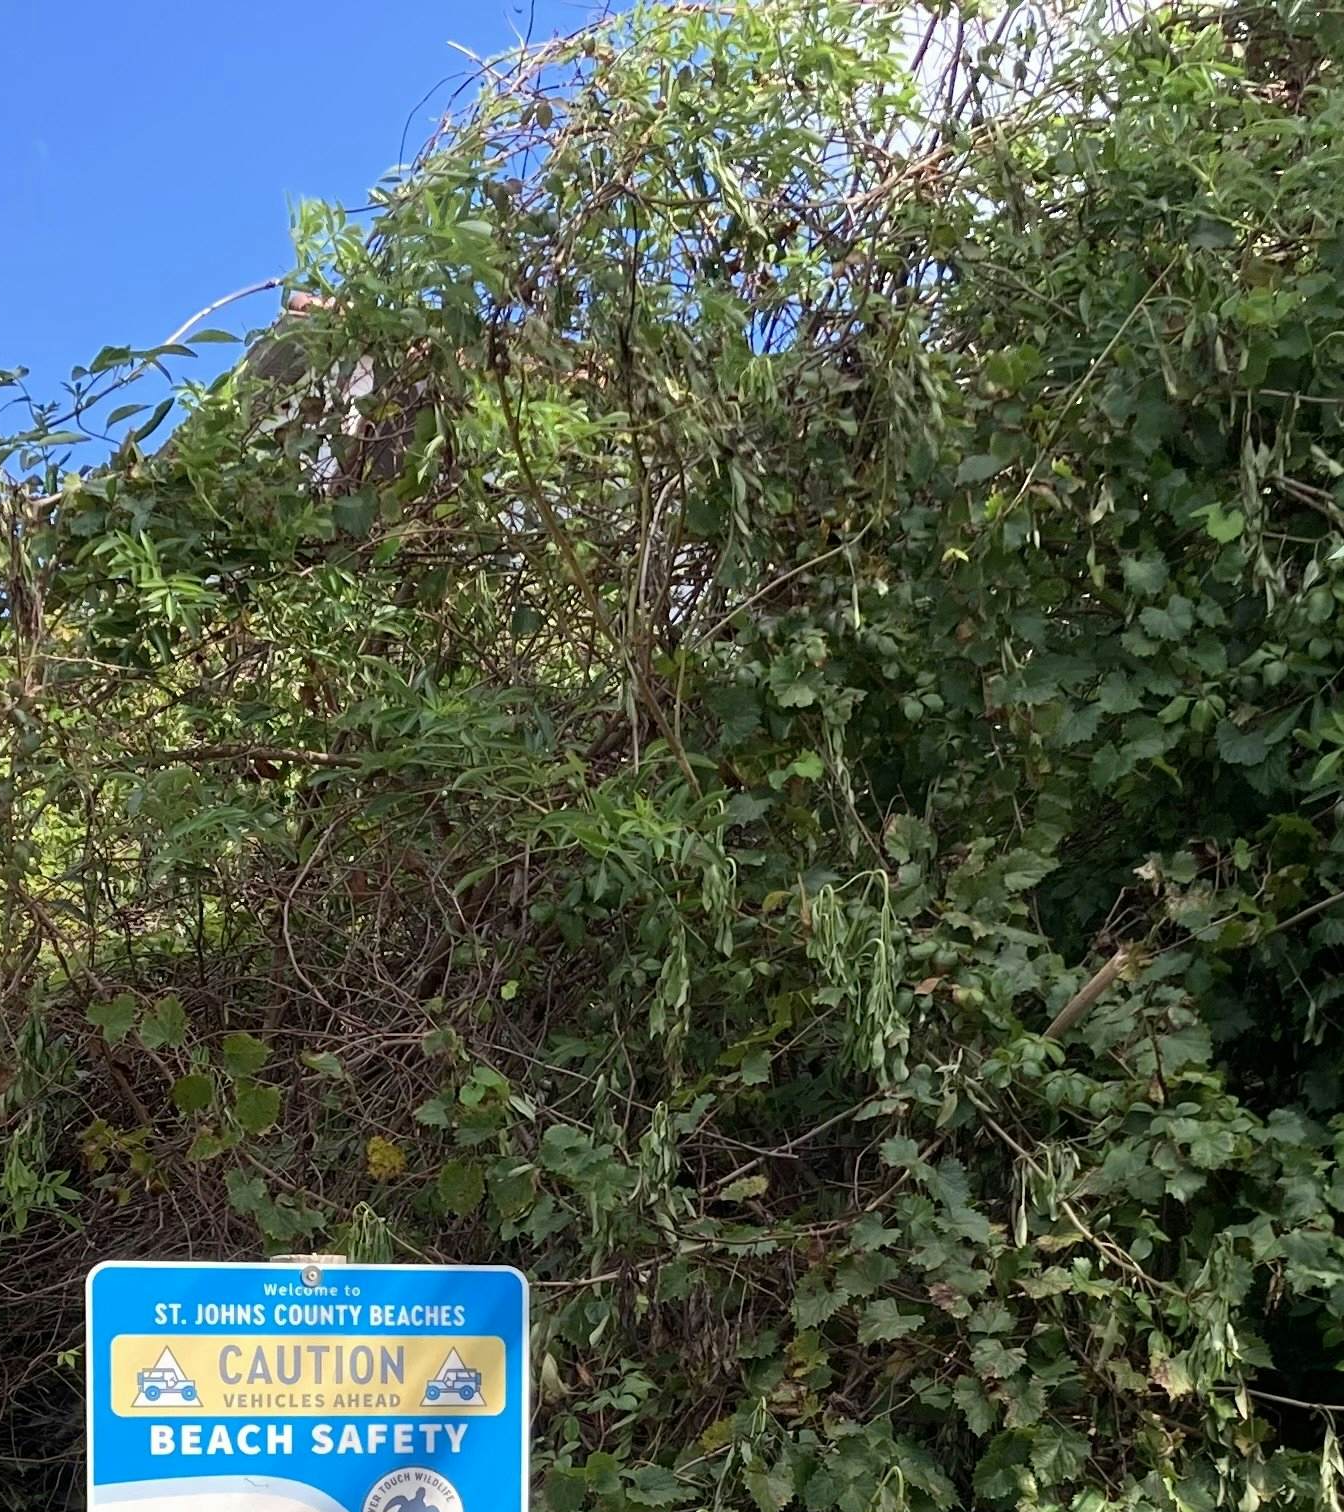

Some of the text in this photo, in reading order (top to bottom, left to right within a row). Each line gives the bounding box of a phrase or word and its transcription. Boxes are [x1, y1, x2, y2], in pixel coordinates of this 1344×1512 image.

[263, 1283, 360, 1297] Welcome to
[154, 1303, 464, 1326] ST. JOHNS COUNTY BEACHES
[218, 1344, 404, 1385] CAUTION
[222, 1392, 401, 1408] VEHICLES AHEAD
[150, 1423, 468, 1455] BEACH SAFETY
[379, 1473, 410, 1494] TOUCH
[414, 1472, 456, 1503] WILDLIFE
